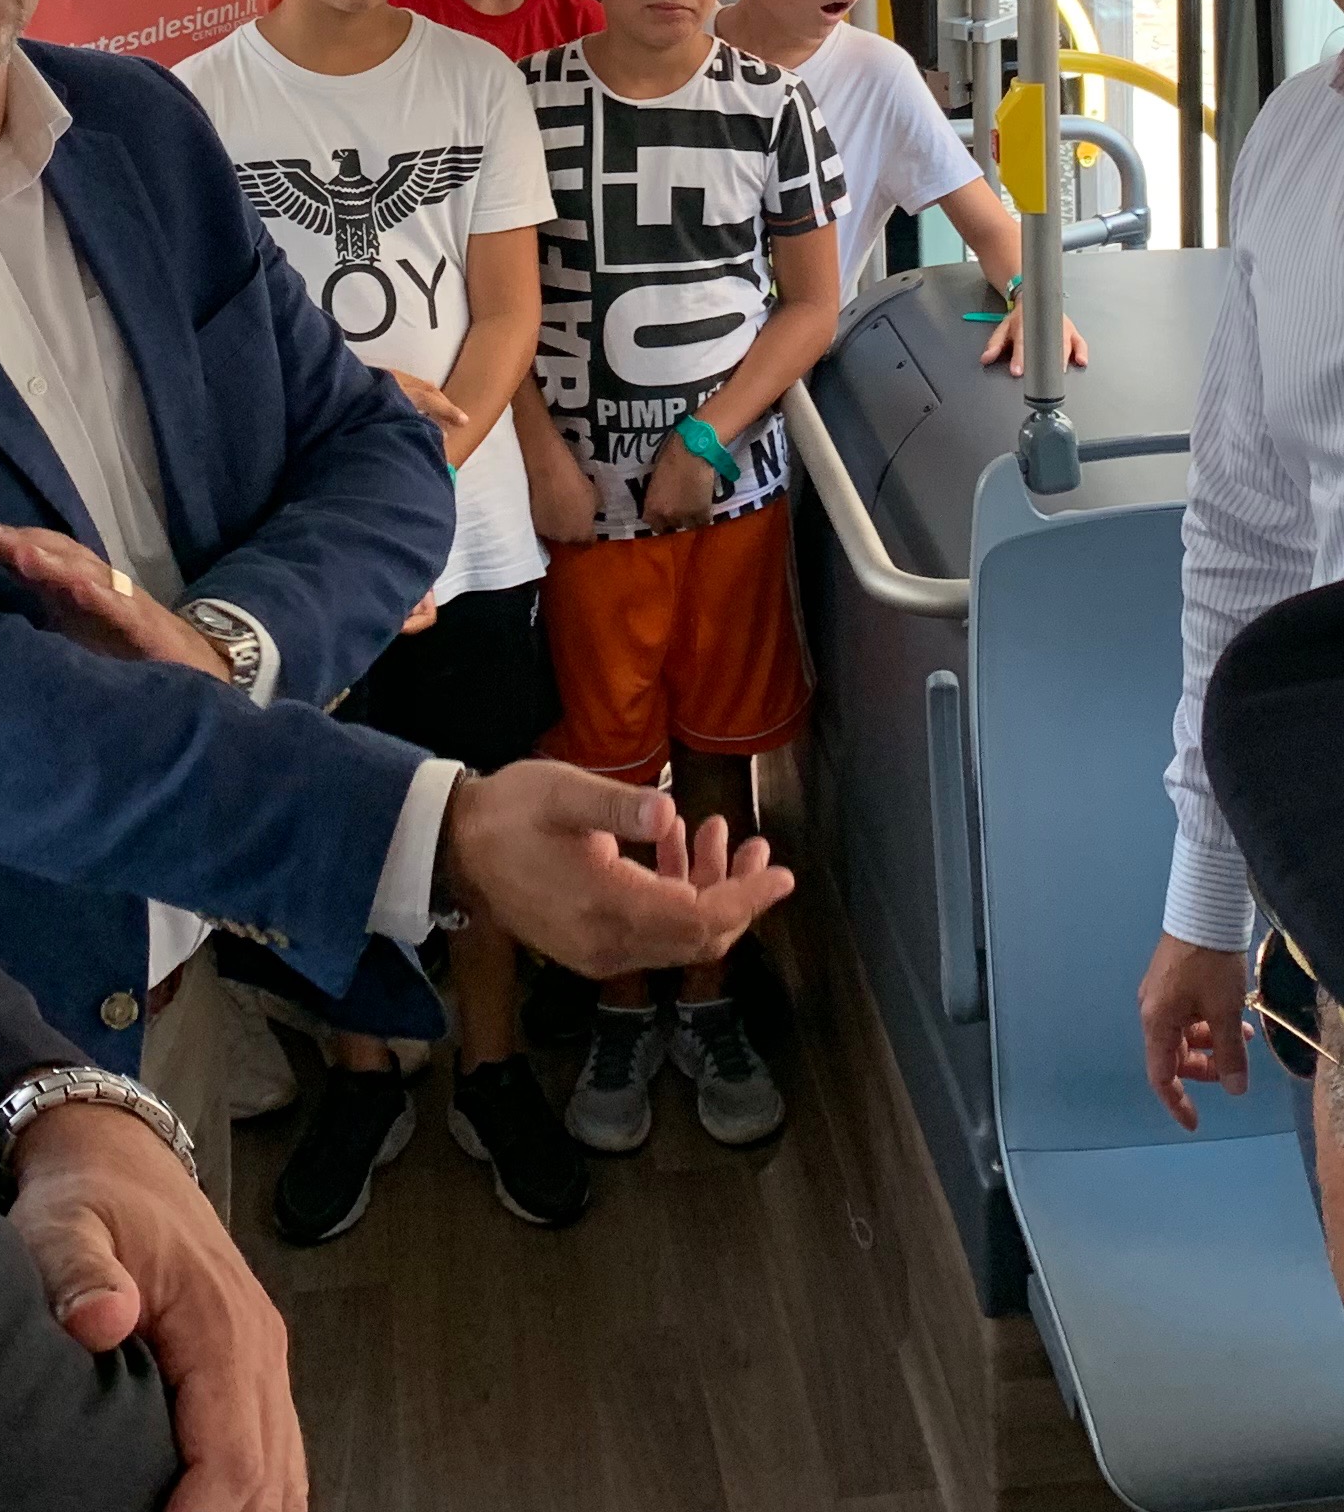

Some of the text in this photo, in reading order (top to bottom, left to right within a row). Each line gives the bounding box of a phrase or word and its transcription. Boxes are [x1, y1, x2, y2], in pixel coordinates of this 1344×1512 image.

[191, 21, 233, 42] CENTRO
[321, 254, 447, 343] OY
[596, 397, 687, 429] PIMP
